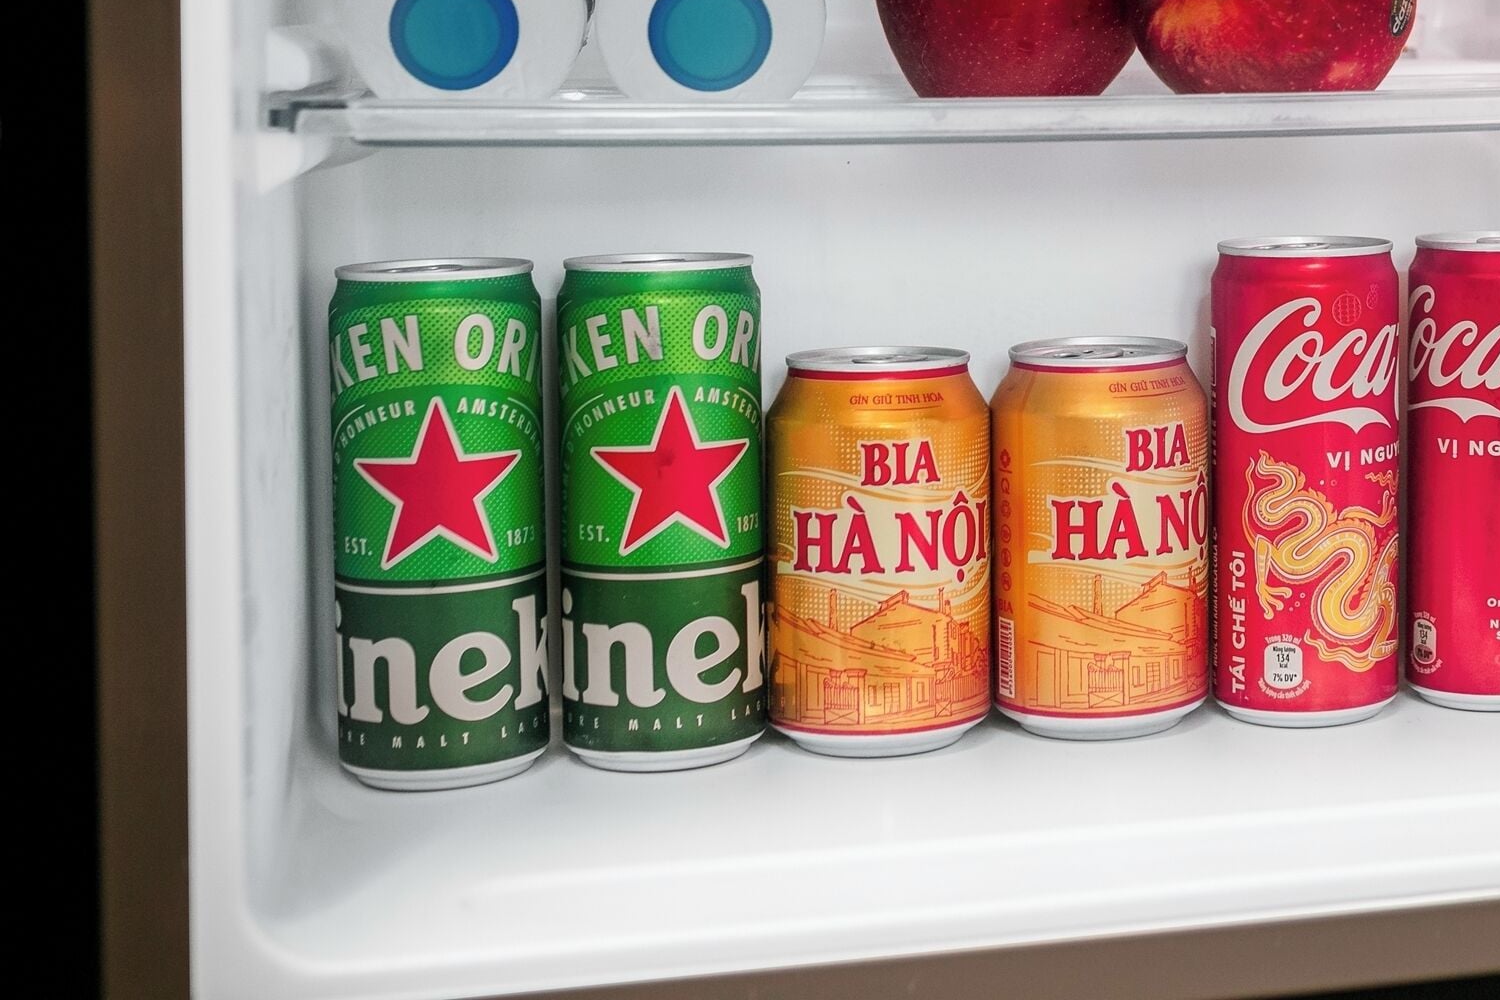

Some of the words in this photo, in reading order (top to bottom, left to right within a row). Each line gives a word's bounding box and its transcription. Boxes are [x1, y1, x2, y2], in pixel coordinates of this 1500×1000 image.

[896, 393, 920, 405] TINH
[922, 391, 945, 403] HOA
[1125, 423, 1191, 473] BIA
[1327, 450, 1351, 471] VỊ
[1438, 437, 1458, 458] VỊ
[860, 440, 941, 487] BIA
[579, 524, 610, 543] EST.
[736, 513, 759, 533] 1873
[1051, 481, 1149, 561] HÀ
[345, 536, 373, 556] EST.
[506, 526, 535, 548] 1873
[793, 495, 886, 575] HÀ
[894, 490, 987, 583] NỘI
[1229, 550, 1246, 591] TÔI
[1229, 594, 1246, 650] CHẾ
[1281, 633, 1293, 642] 320
[1277, 653, 1290, 662] 134
[1229, 656, 1246, 694] TÁI
[1273, 673, 1283, 682] 7%
[628, 715, 703, 731] MALT
[392, 732, 470, 748] MALT
